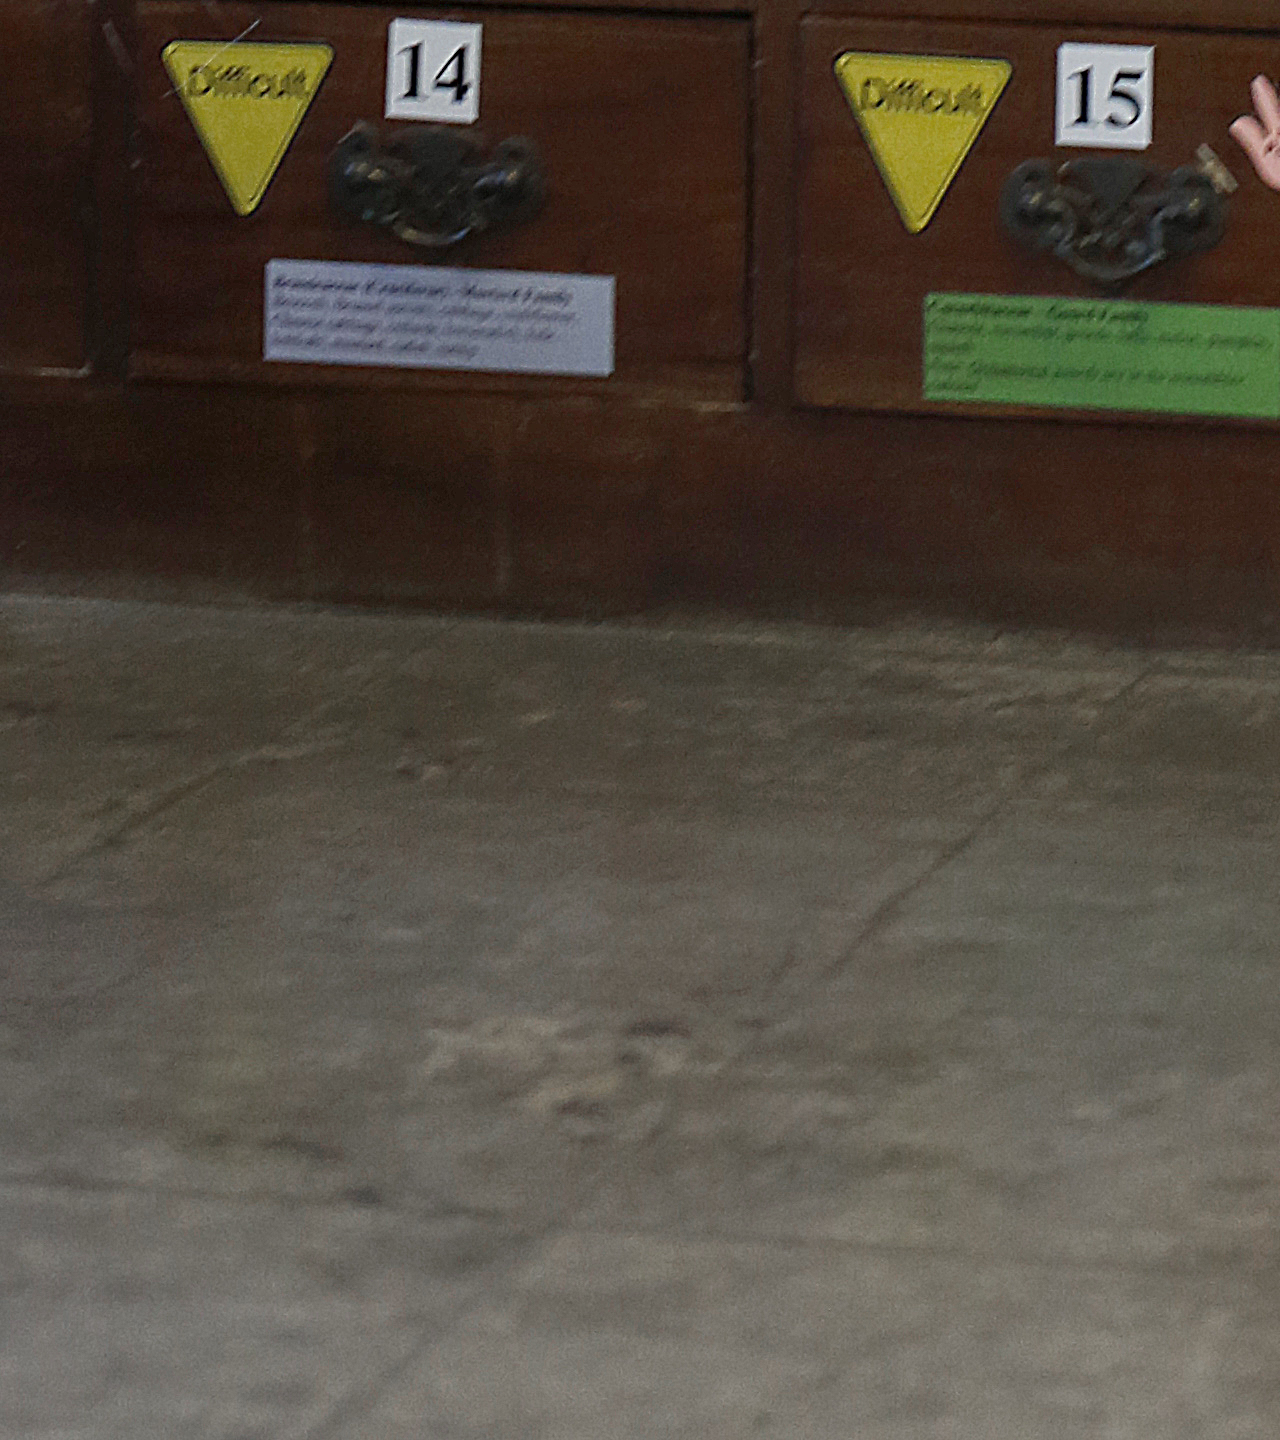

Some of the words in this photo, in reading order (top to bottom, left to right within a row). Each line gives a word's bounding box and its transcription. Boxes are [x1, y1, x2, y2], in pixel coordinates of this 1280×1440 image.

[186, 63, 310, 99] Difficult
[394, 40, 472, 105] 14
[859, 75, 985, 116] Difficult
[1064, 66, 1147, 129] 15
